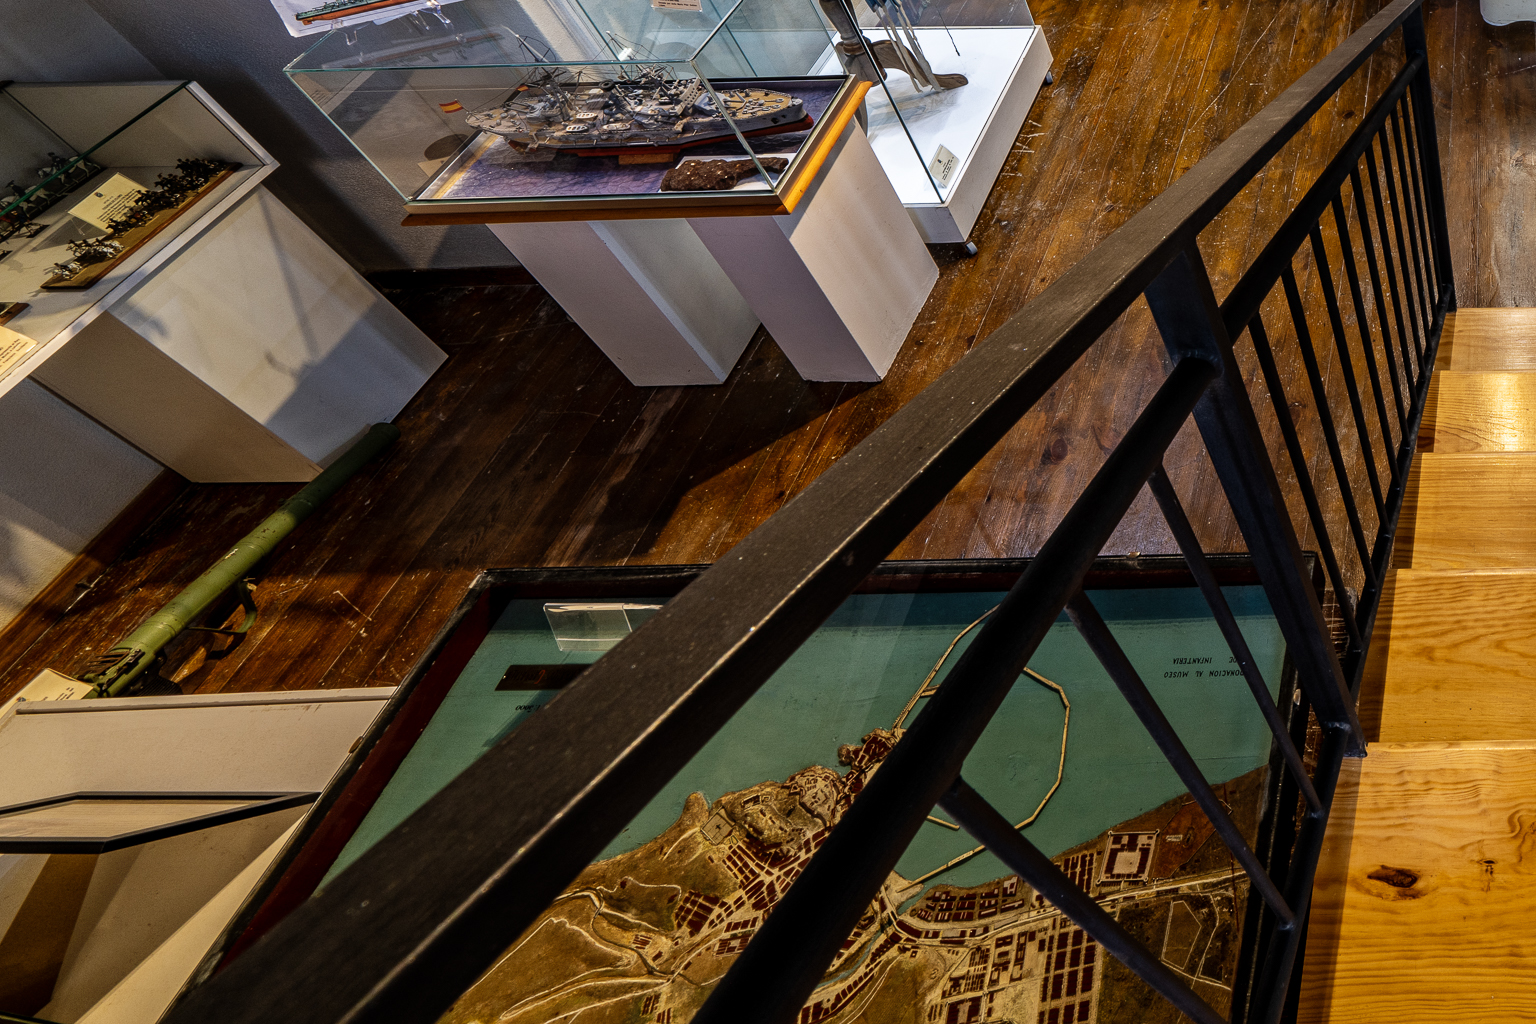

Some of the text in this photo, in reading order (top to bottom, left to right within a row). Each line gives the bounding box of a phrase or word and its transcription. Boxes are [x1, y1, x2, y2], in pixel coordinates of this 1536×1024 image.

[1172, 657, 1212, 665] INFANTERIA
[1163, 669, 1244, 678] DONACION AL MUSEO
